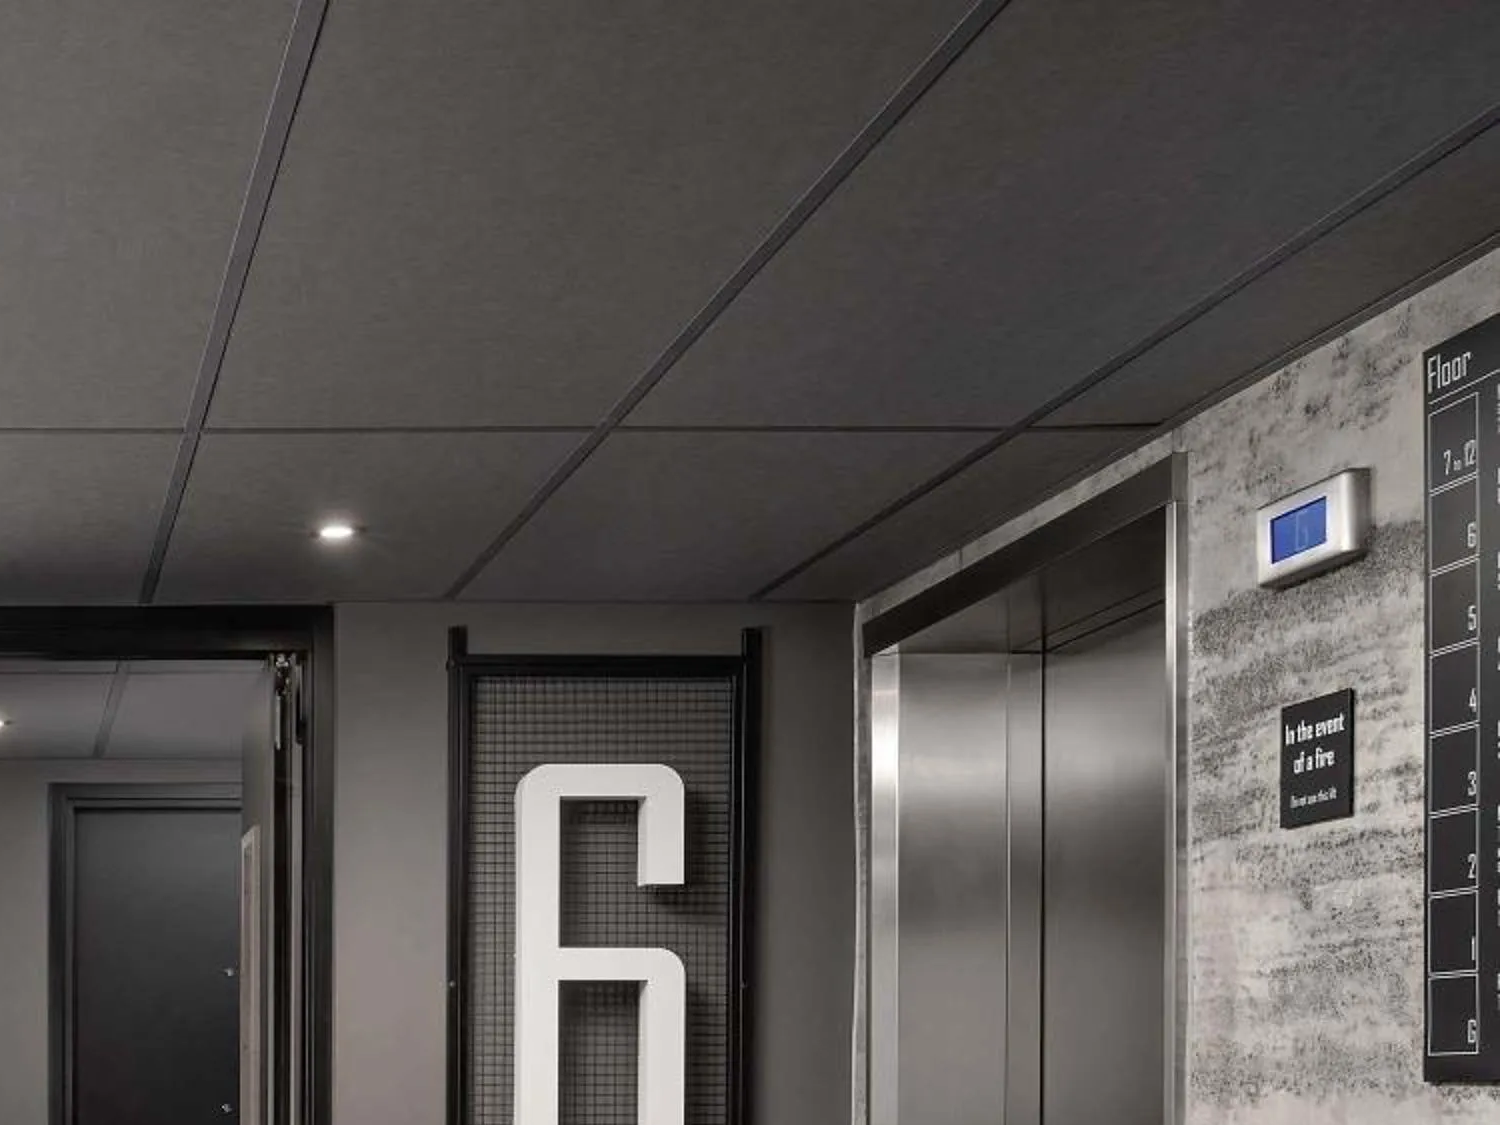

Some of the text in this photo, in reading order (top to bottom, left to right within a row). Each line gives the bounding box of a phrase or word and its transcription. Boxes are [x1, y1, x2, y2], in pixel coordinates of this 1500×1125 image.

[1427, 351, 1472, 395] Floor
[1443, 449, 1452, 476] 7
[1467, 522, 1477, 548] 6
[1467, 605, 1477, 631] 5
[1469, 688, 1477, 712] 4
[1285, 712, 1345, 746] In the event
[1293, 747, 1335, 774] of a fire
[1467, 770, 1477, 796] 3
[1467, 853, 1477, 879] 2
